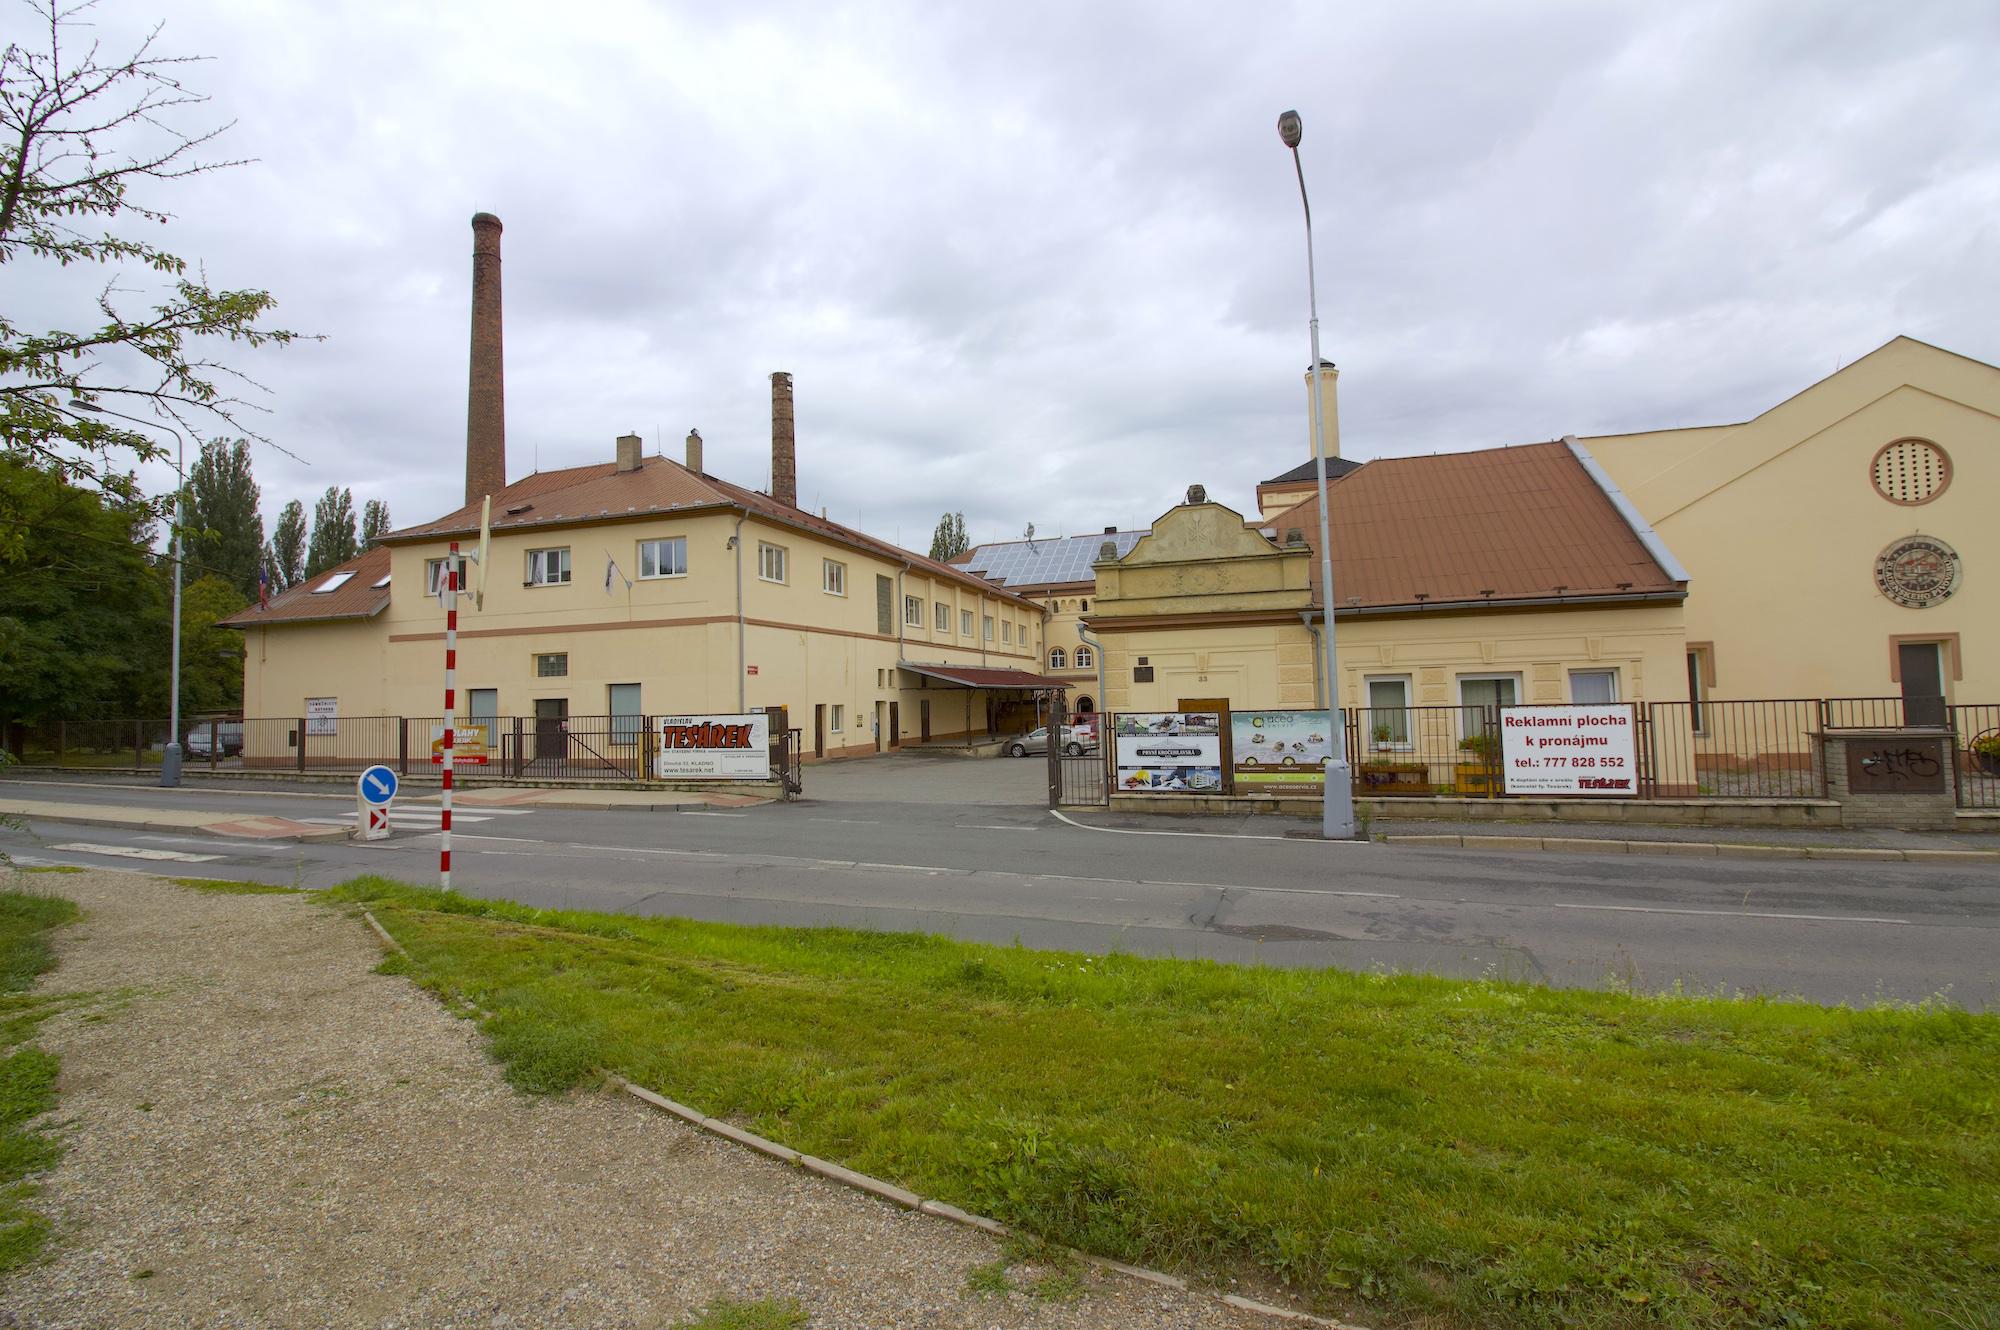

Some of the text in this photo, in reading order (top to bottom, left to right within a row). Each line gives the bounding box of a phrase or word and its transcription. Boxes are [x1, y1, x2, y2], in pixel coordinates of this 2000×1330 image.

[1267, 715, 1293, 723] aceo
[1505, 714, 1627, 728] Reklamní plocha
[663, 721, 754, 749] TESÁREK
[1526, 735, 1608, 748] k pronájmu
[1515, 757, 1624, 767] tel.: 777 828 552
